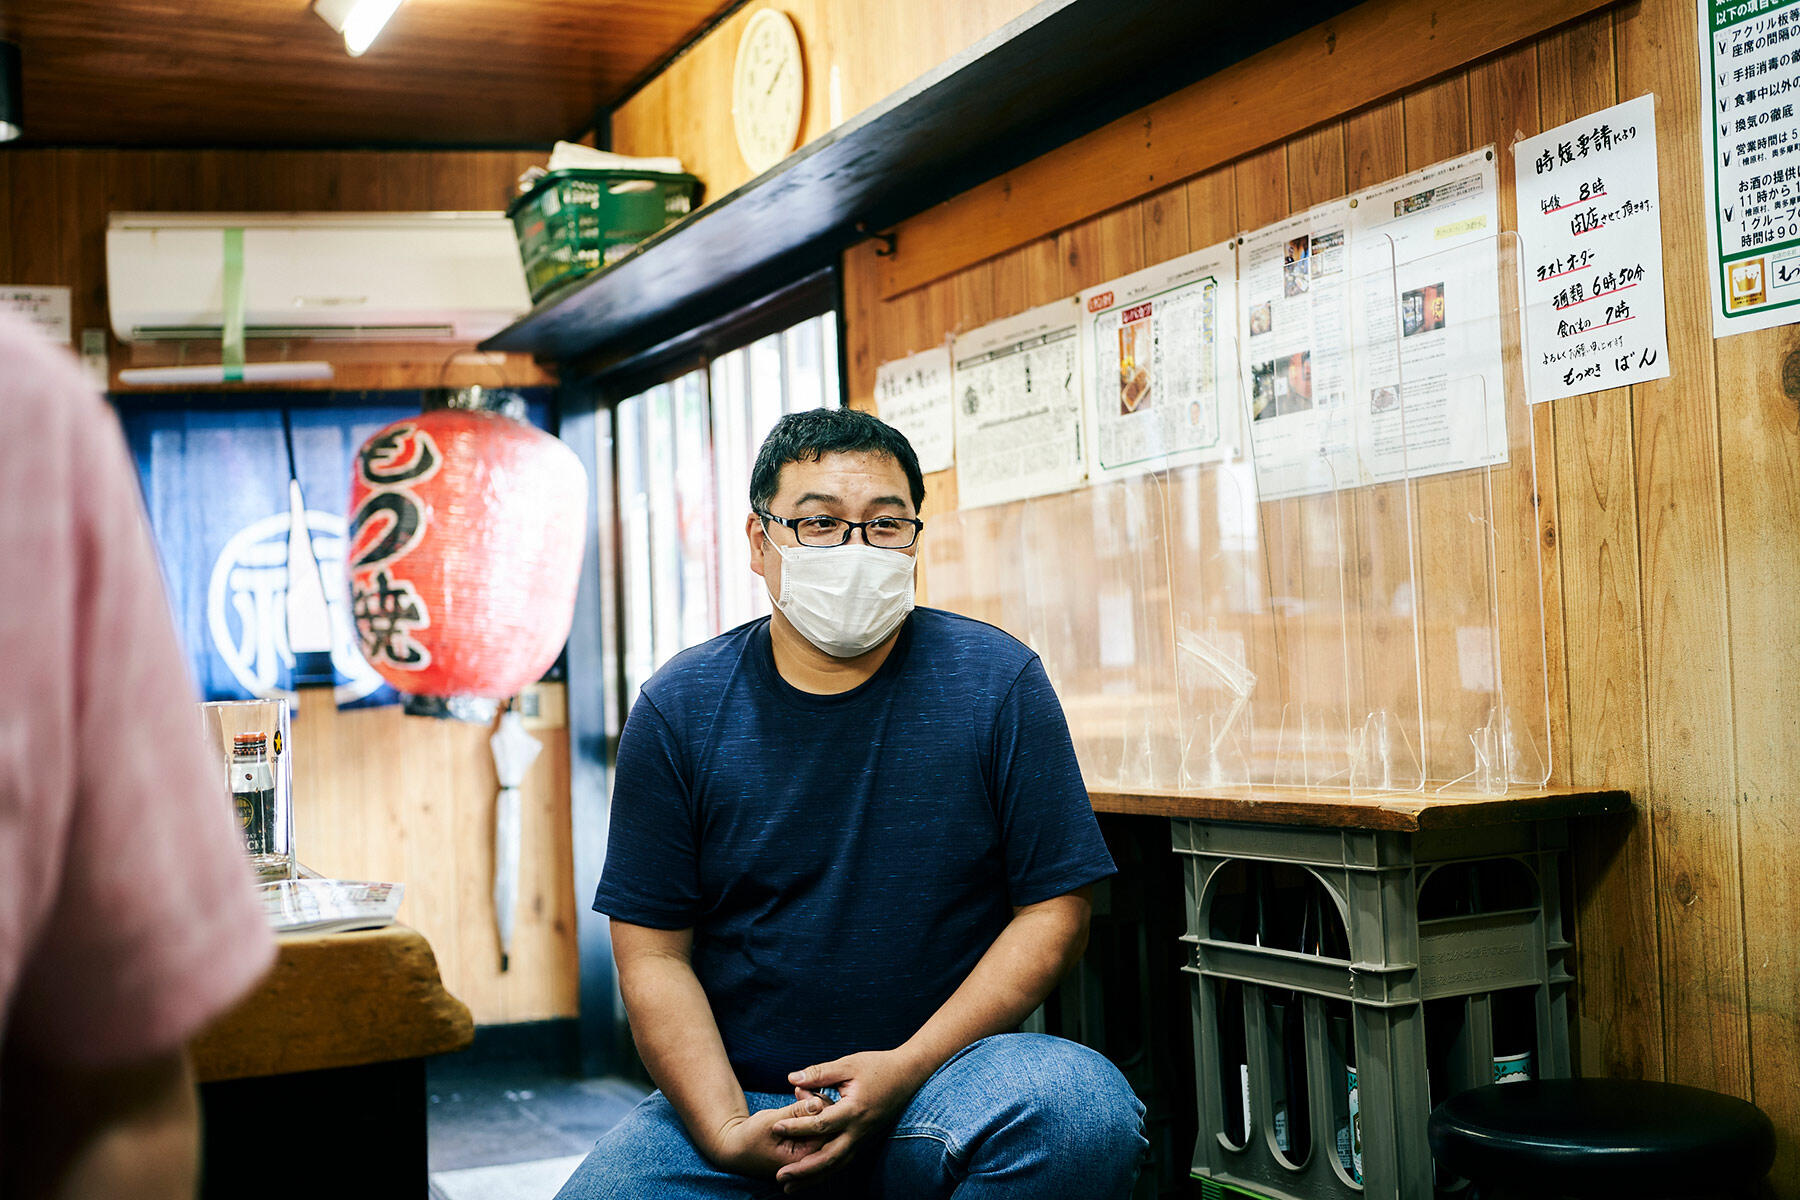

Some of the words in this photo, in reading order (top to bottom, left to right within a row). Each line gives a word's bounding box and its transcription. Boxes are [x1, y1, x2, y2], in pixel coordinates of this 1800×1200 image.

[1732, 8, 1799, 42] アクリル板等
[1735, 104, 1794, 133] 換気の徹底
[1536, 125, 1636, 174] 時短要請により
[1541, 194, 1561, 212] 午後
[1741, 223, 1798, 248] 時間は90
[1552, 283, 1584, 309] 酒類
[1557, 317, 1591, 338] 食べもの
[1605, 300, 1630, 325] 7時
[1615, 347, 1657, 372] ばん
